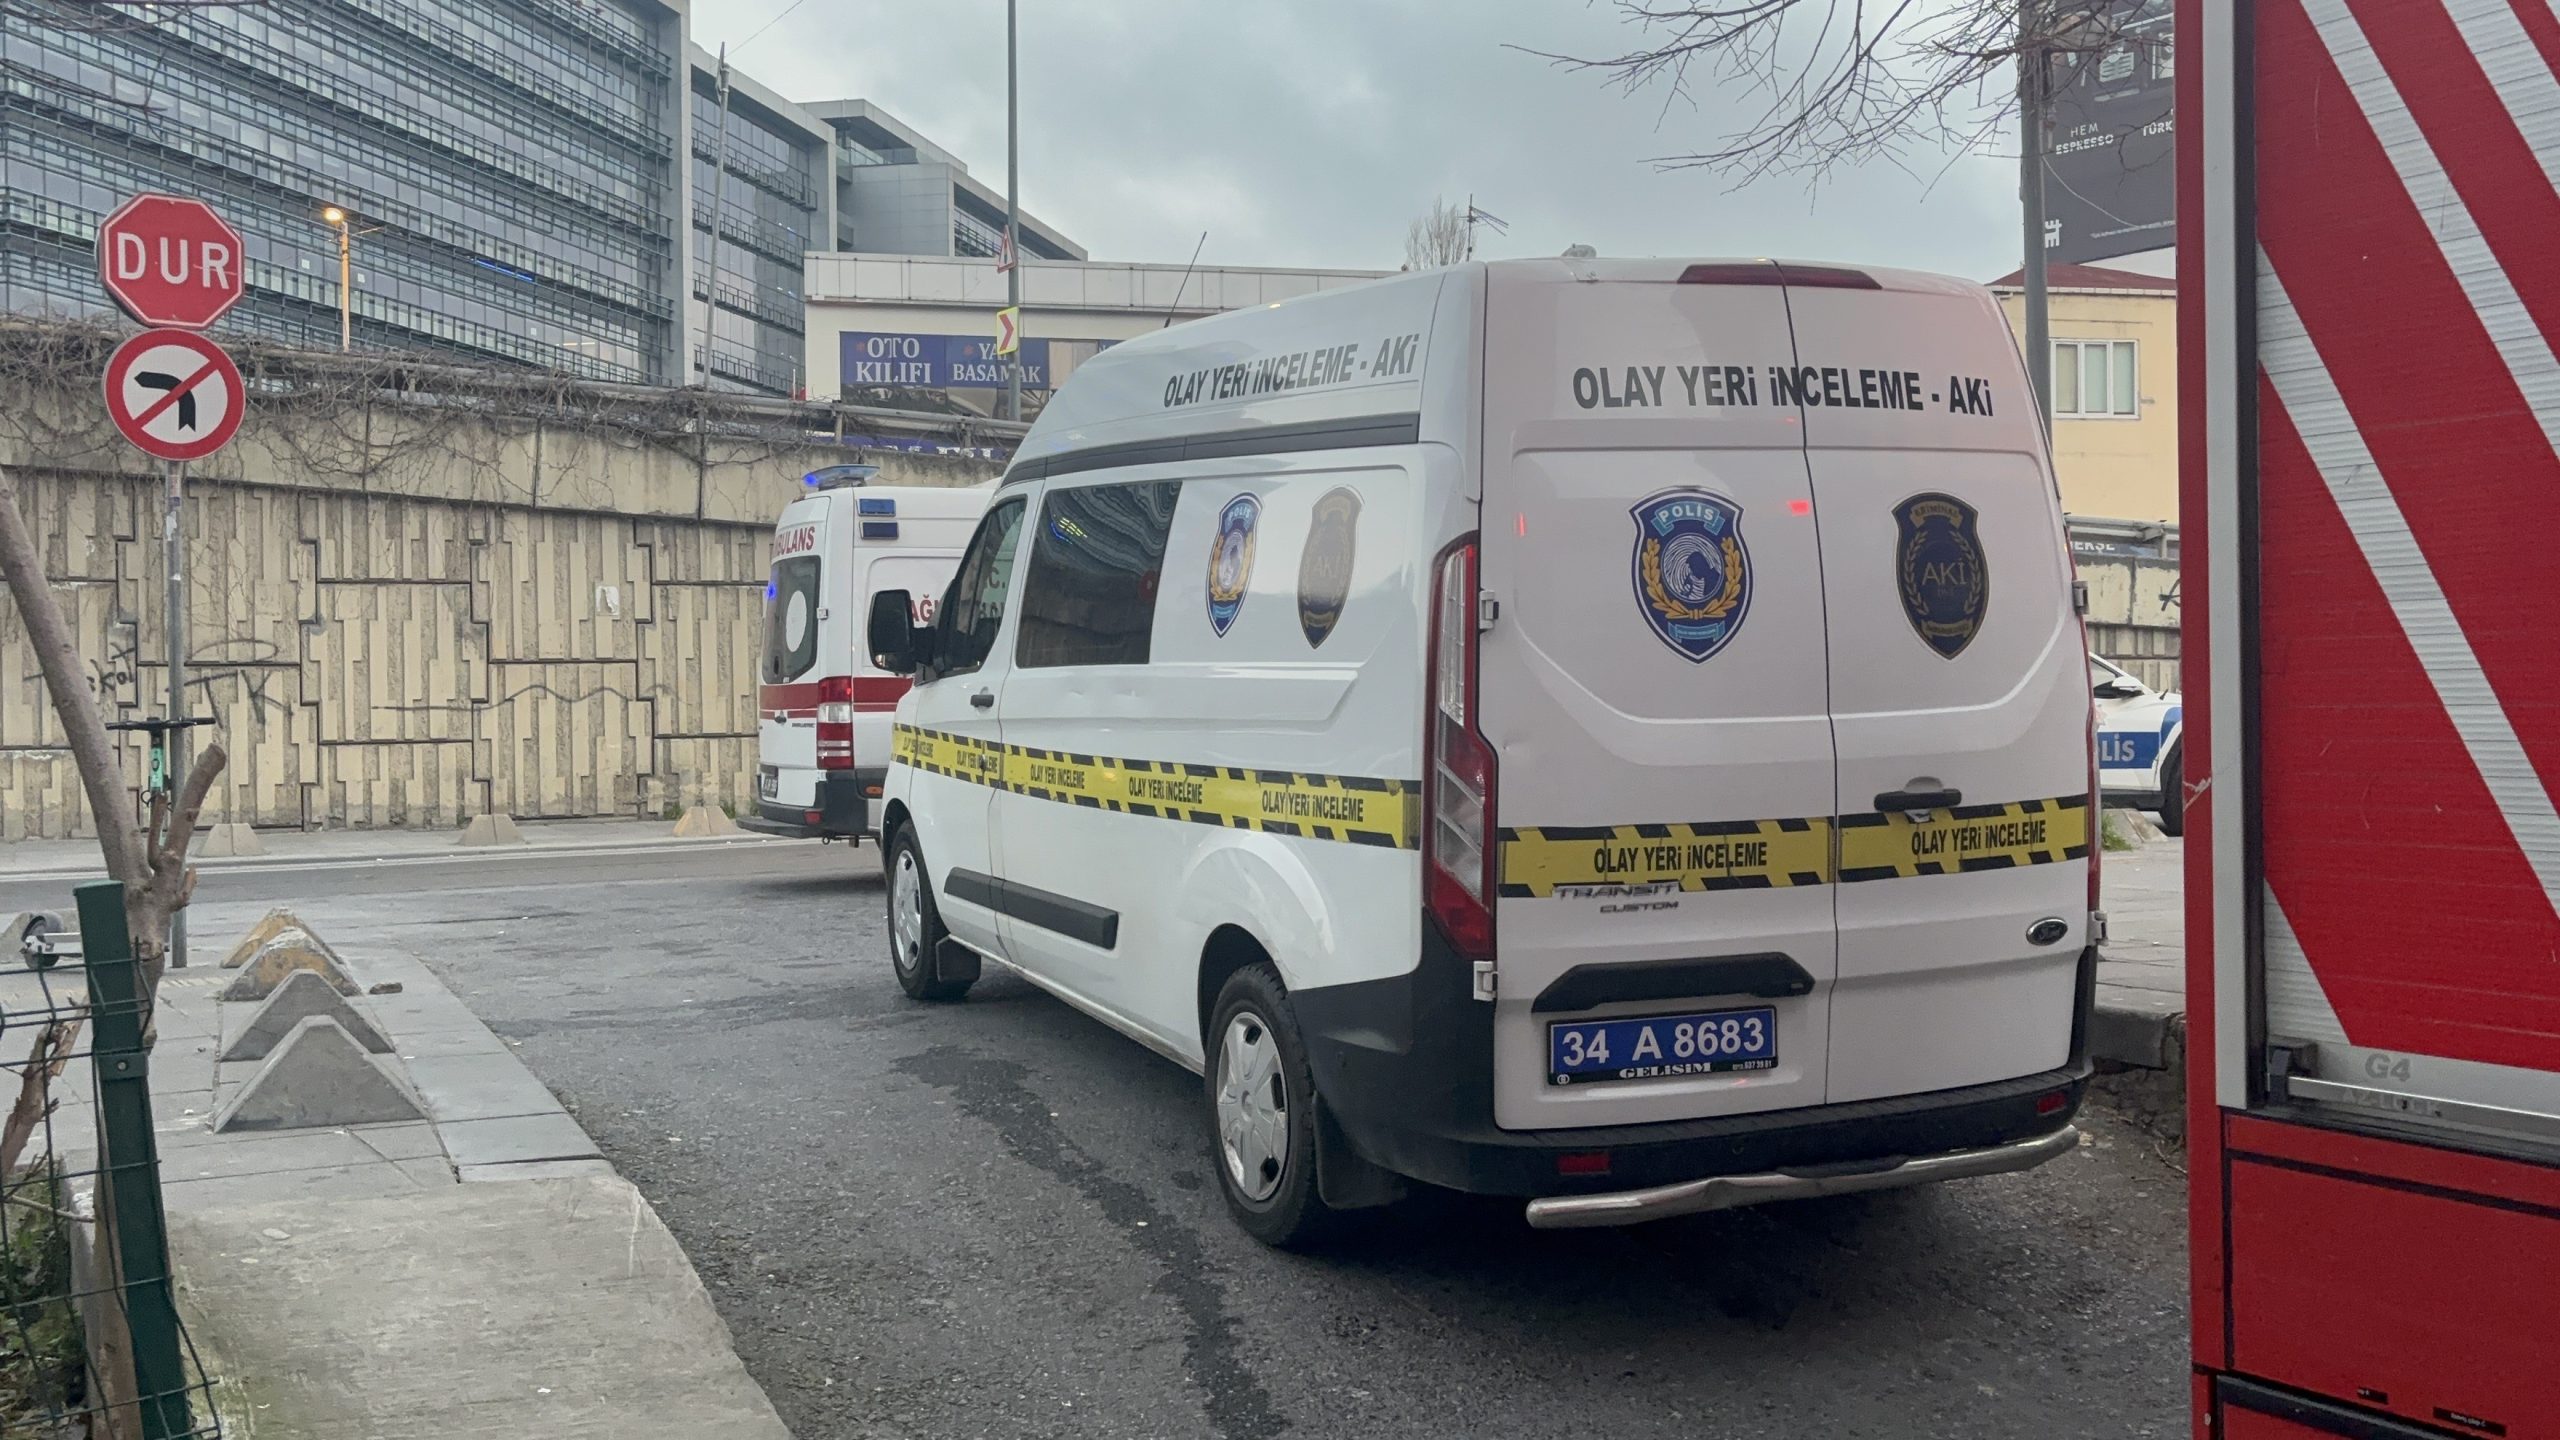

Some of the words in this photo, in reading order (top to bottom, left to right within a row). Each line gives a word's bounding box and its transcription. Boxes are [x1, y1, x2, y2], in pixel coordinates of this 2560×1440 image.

[2070, 122, 2099, 137] HEM
[2056, 134, 2114, 155] ESPRESSO
[117, 231, 230, 290] DUR
[867, 337, 920, 358] OTO
[855, 361, 932, 383] KILIFI
[1163, 369, 1208, 408] OLAY
[1573, 366, 1666, 410] OLAY
[1031, 764, 1044, 782] OLAY
[1129, 776, 1146, 797] OLAY
[1262, 790, 1287, 813] OLAY
[1912, 829, 1948, 855] OLAY
[1594, 848, 1639, 874] OLAY
[1600, 901, 1679, 914] CUSTOM
[1562, 1029, 1610, 1067] 34
[1632, 1026, 1663, 1061] A
[1674, 1018, 1765, 1058] 8683
[2364, 1053, 2411, 1082] G4
